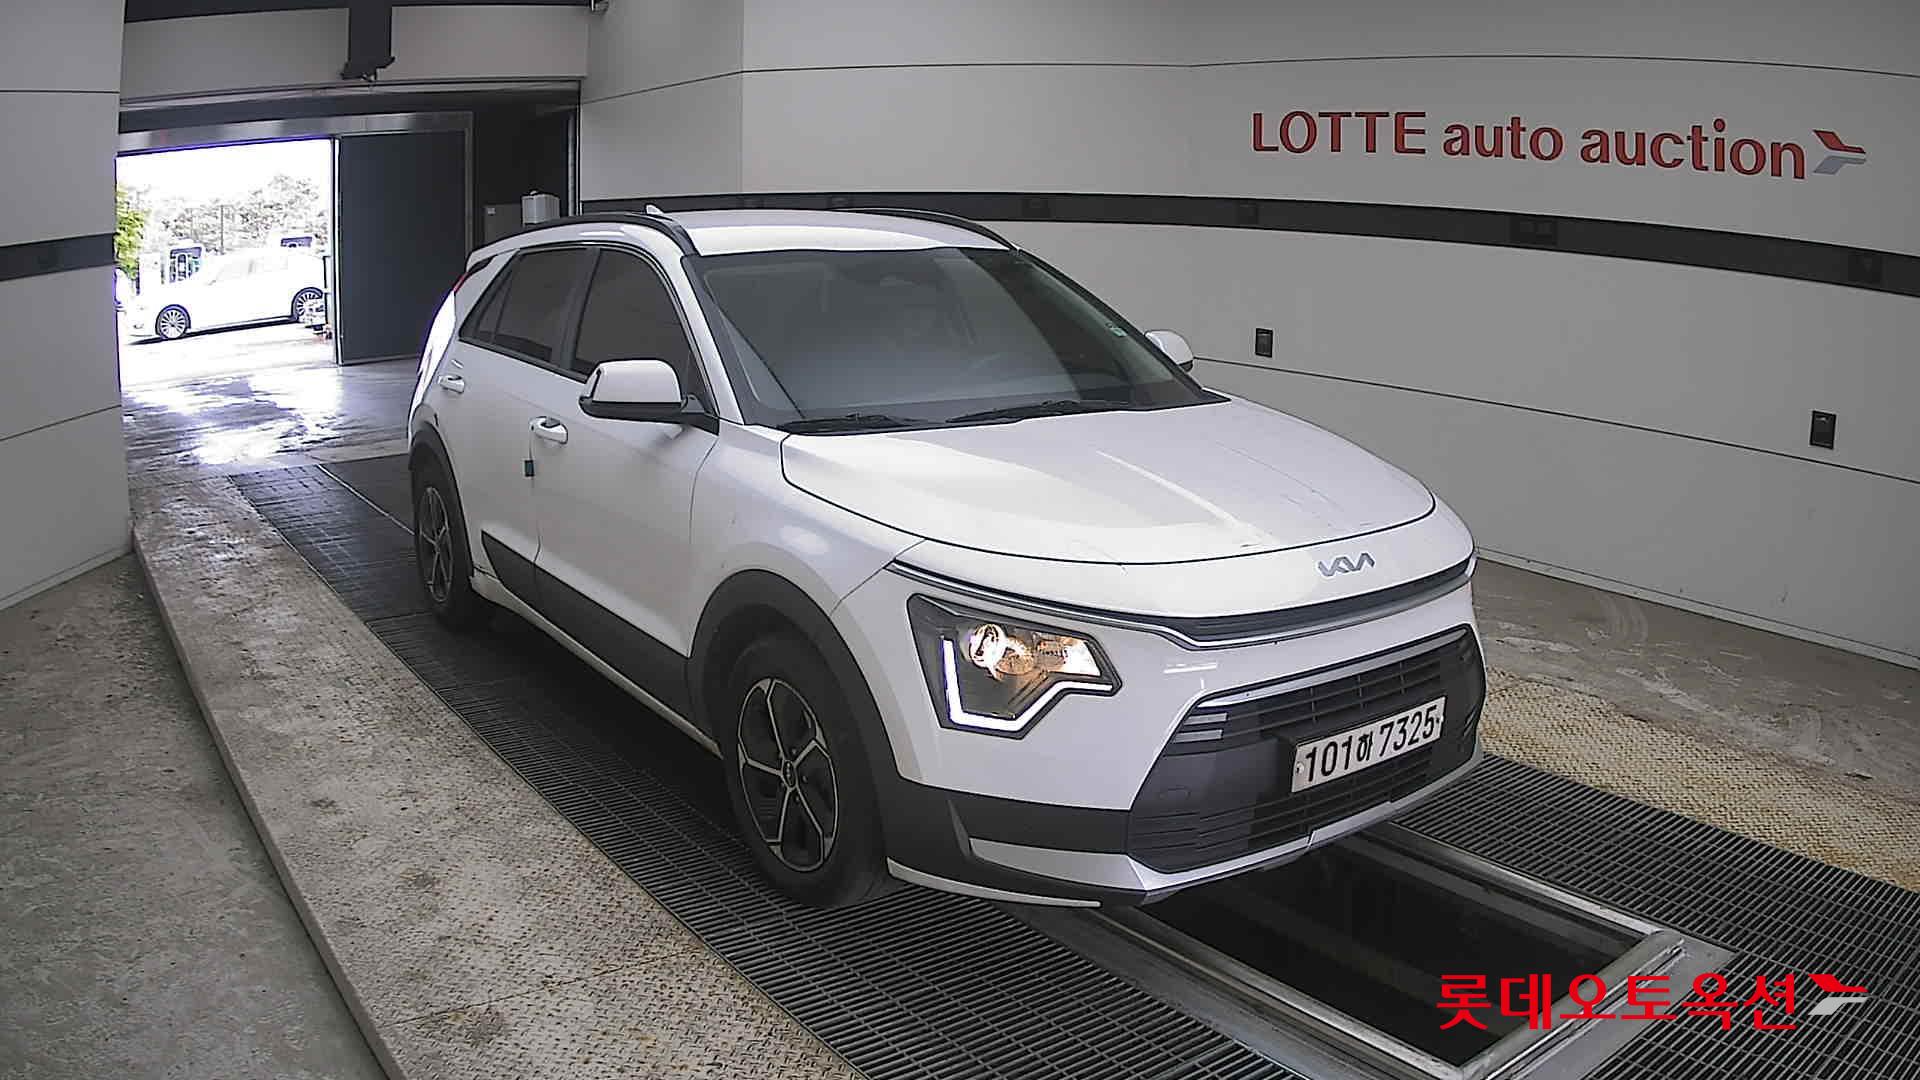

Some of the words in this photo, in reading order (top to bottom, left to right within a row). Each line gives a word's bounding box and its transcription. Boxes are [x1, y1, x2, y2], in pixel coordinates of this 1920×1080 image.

[1252, 111, 1427, 154] LOTTE
[1443, 116, 1564, 162] auto
[1580, 118, 1807, 179] auction
[1378, 704, 1437, 757] 7325
